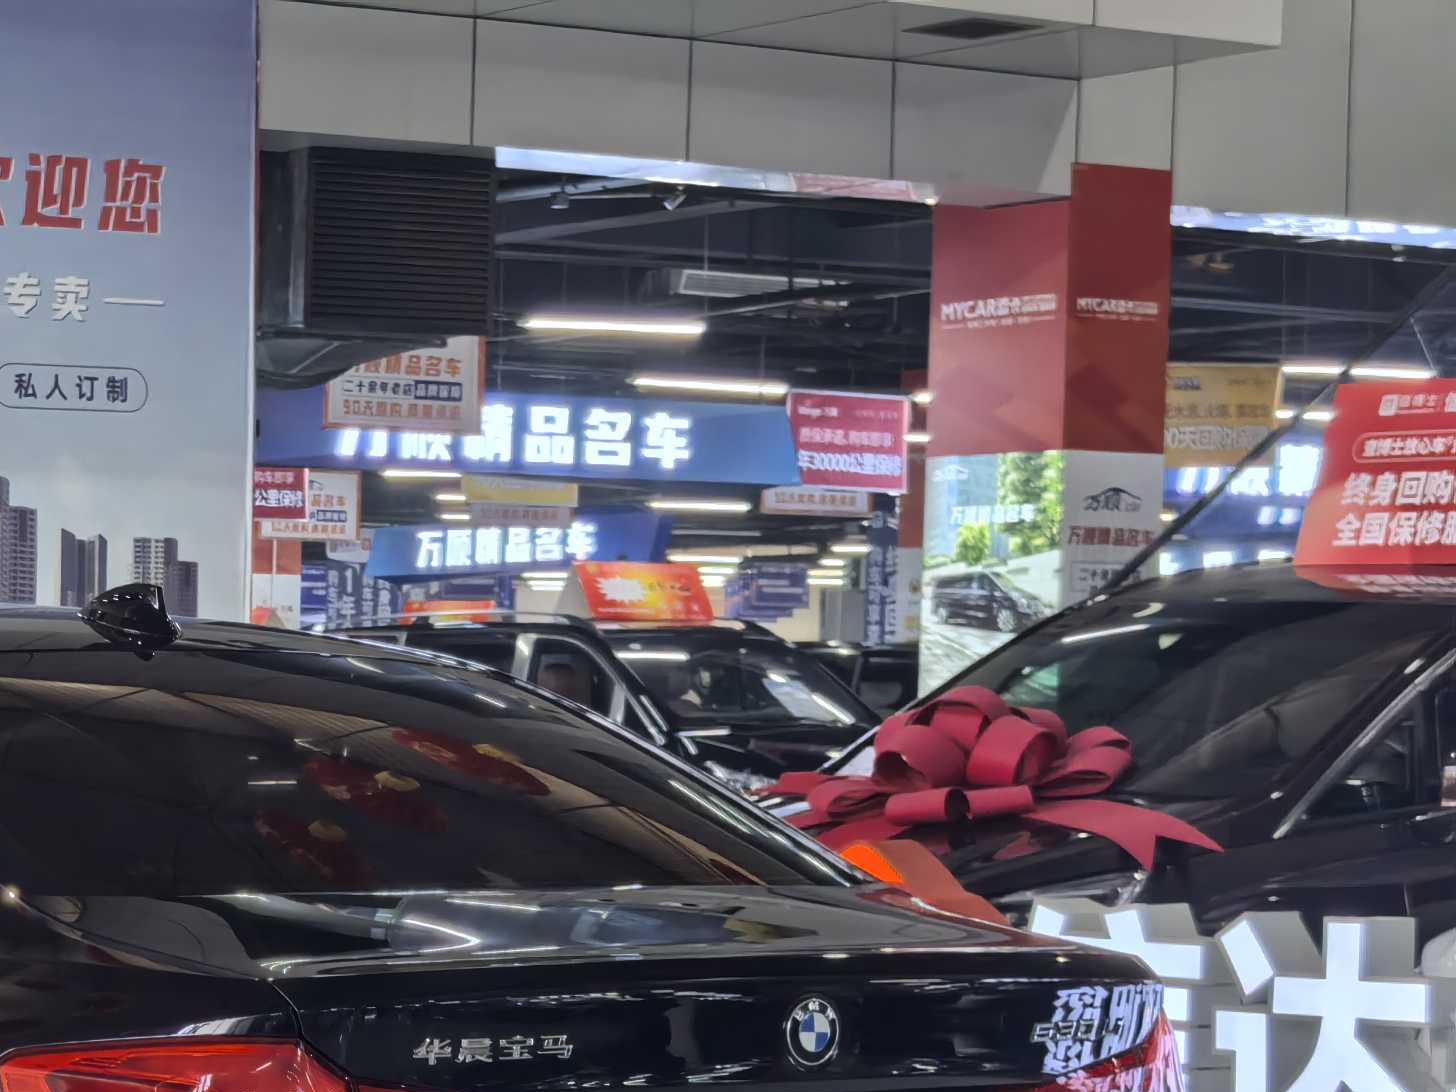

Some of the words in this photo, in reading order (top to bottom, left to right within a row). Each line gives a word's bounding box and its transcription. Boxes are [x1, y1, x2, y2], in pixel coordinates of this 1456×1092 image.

[13, 373, 130, 404] 私人订制
[412, 1033, 574, 1066] 华晨宝马
